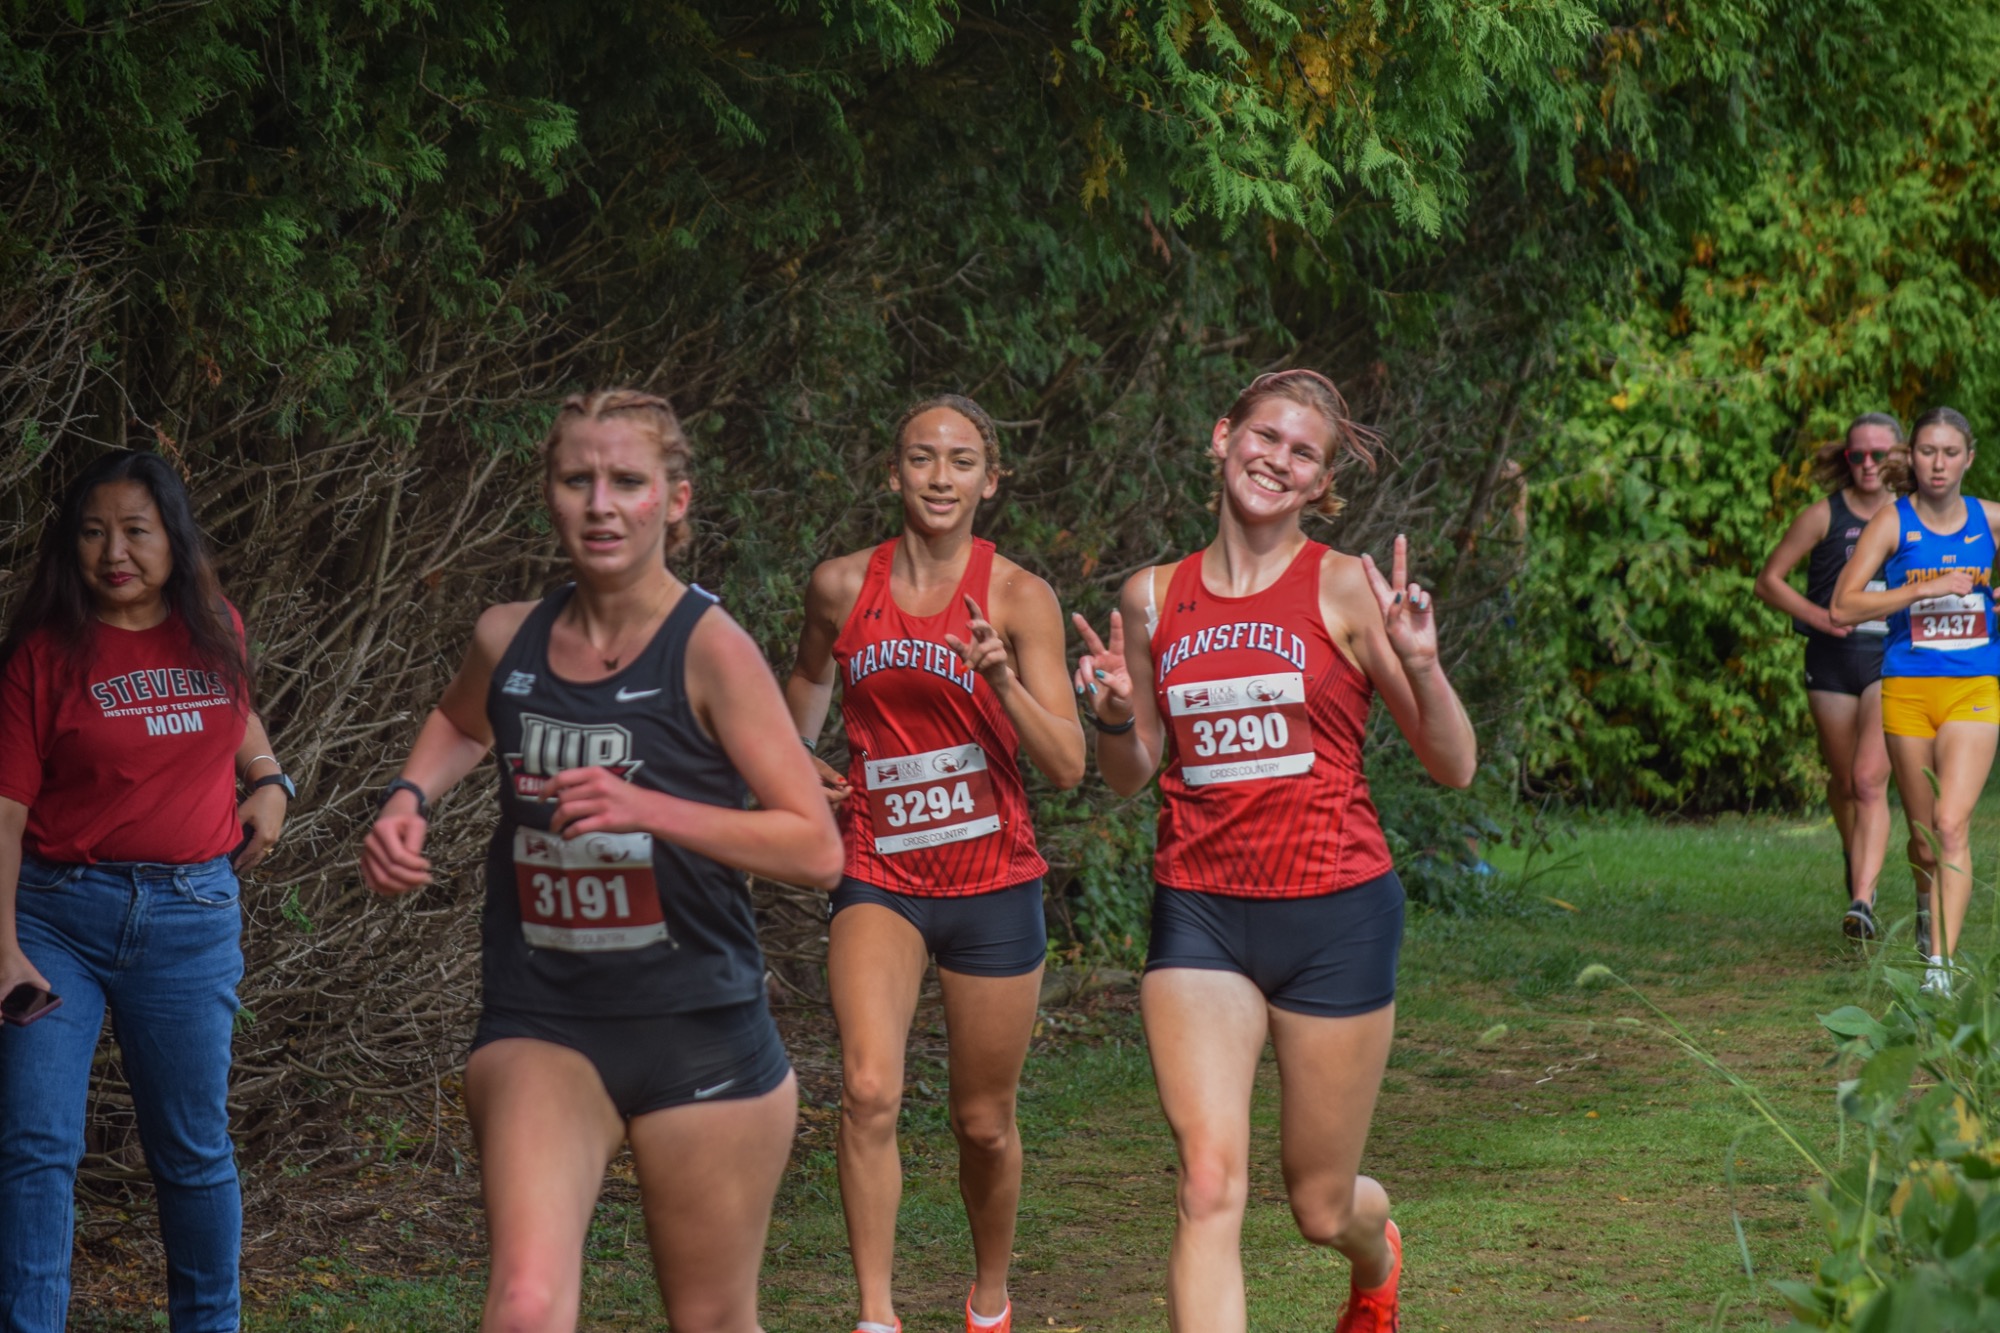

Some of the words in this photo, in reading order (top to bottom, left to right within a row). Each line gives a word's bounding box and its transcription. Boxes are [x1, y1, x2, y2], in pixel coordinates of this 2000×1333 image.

[1923, 614, 1976, 638] 3437
[1159, 622, 1306, 684] MANSFIELD
[91, 668, 226, 709] STEVENS
[104, 706, 154, 718] INSTITUTE
[155, 704, 169, 713] OF
[171, 698, 231, 711] TECHNOLOGY
[145, 711, 204, 736] MOM
[1193, 712, 1289, 757] 3290
[521, 716, 629, 775] IUP
[1210, 767, 1238, 779] CROSS
[1239, 763, 1280, 776] COUNTRY
[885, 781, 975, 827] 3294
[903, 835, 930, 847] CROSS
[930, 827, 969, 843] COUNTRY
[532, 873, 630, 920] 3191
